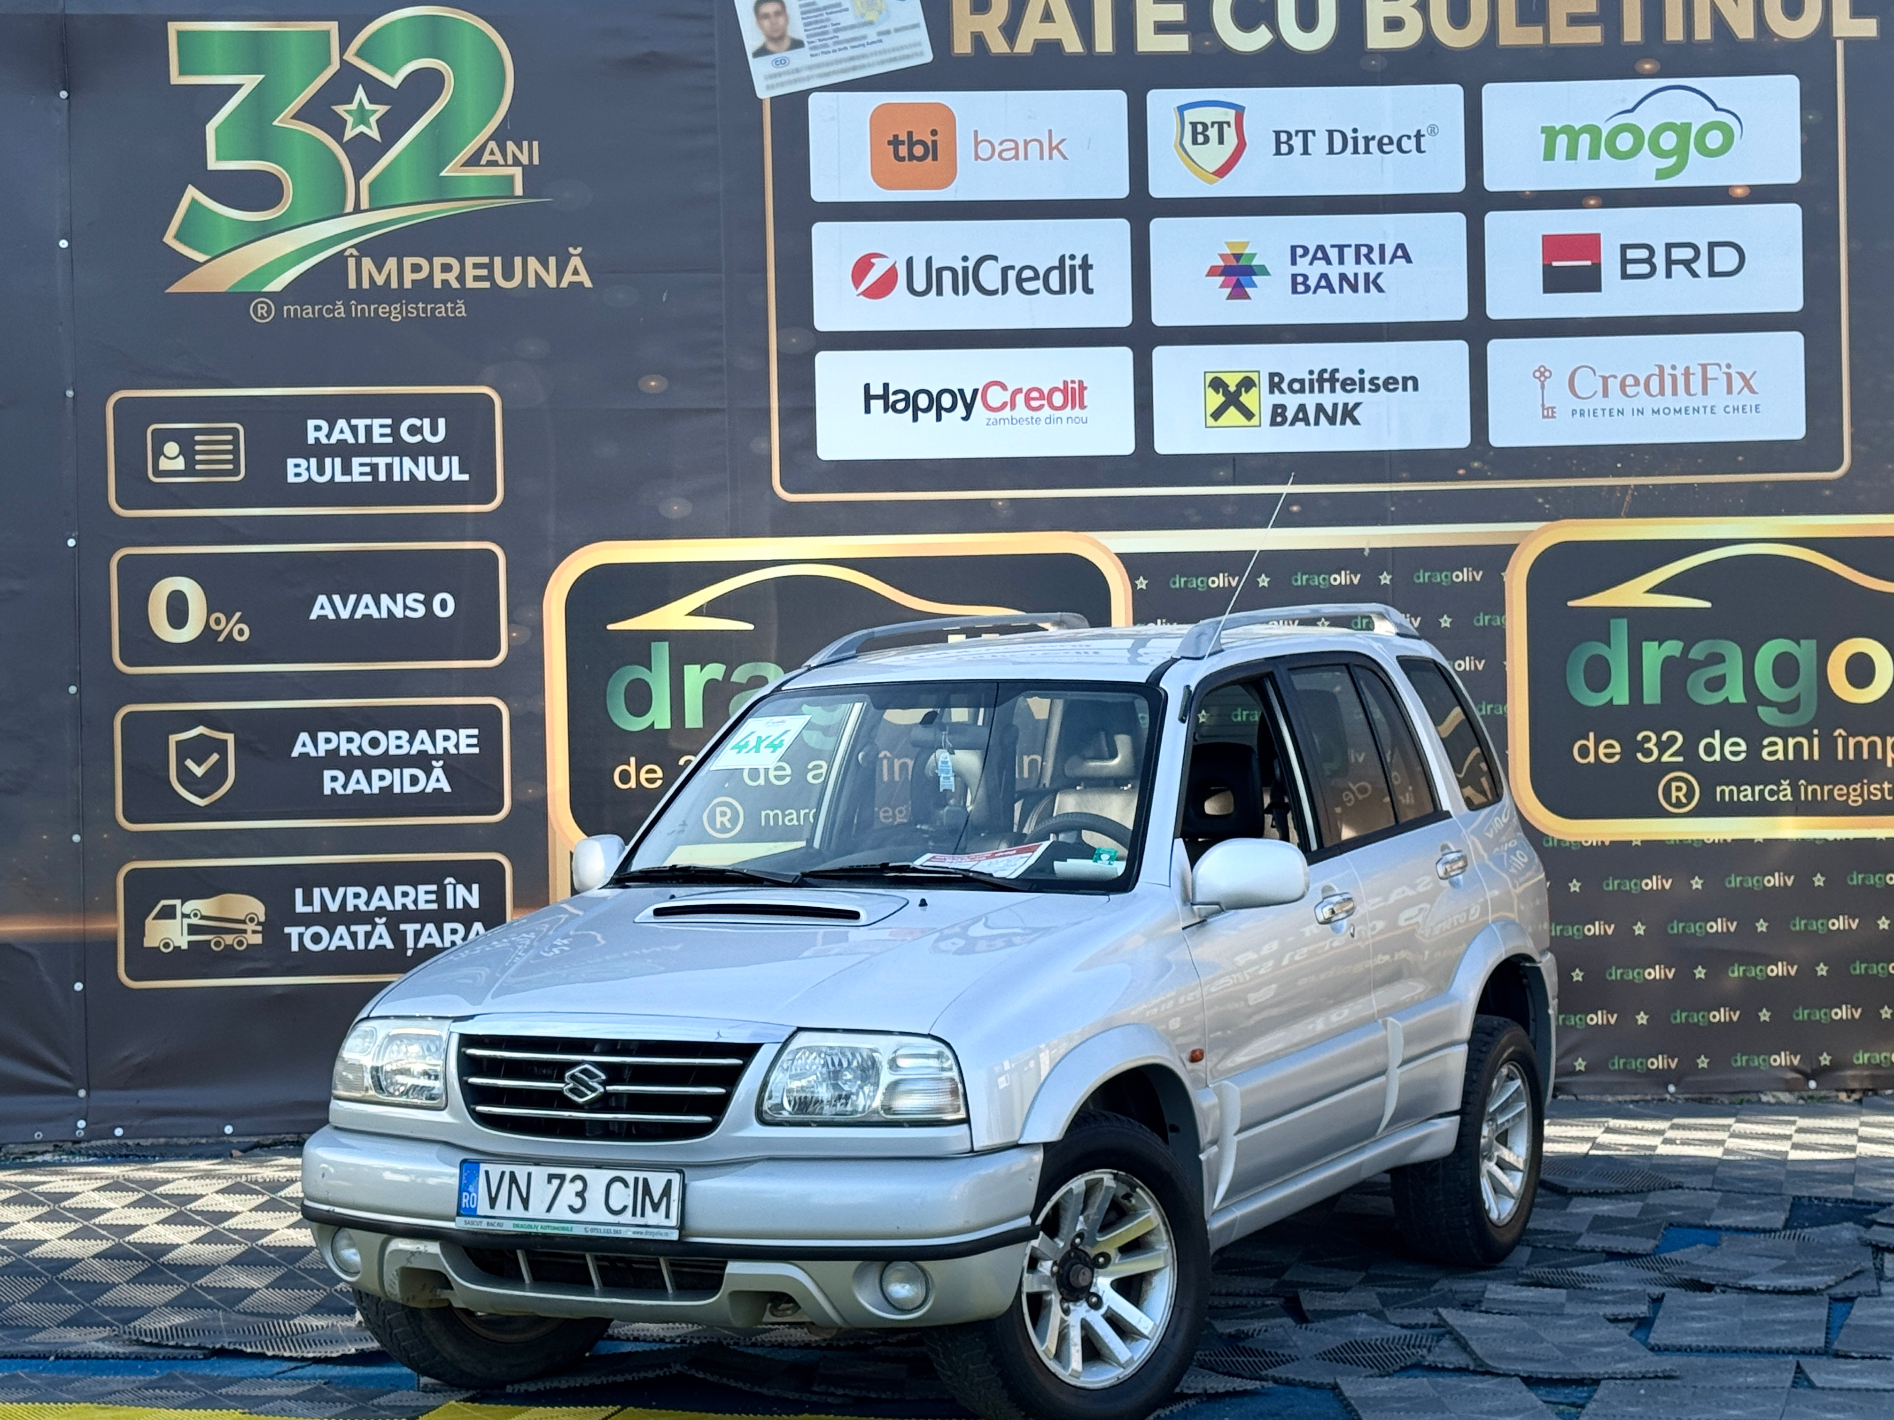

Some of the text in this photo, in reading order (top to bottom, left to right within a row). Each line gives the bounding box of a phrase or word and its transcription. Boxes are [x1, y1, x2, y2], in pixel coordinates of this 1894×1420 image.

[163, 6, 523, 263] 32
[887, 129, 939, 163] tbi
[972, 130, 1069, 162] bank
[1189, 121, 1231, 146] BT
[1272, 129, 1316, 156] BT
[480, 141, 540, 165] ANI
[1541, 120, 1736, 181] mogo
[1290, 243, 1413, 266] PATRIA
[1619, 240, 1746, 280] BRD
[344, 247, 593, 289] ÎMPREUNĂ
[905, 253, 1093, 297] UniCredit
[1291, 272, 1386, 295] BANK
[282, 299, 346, 319] marcă
[349, 299, 467, 323] înregistrată
[1268, 368, 1419, 395] Raiffeisen
[1567, 362, 1759, 400] CreditFix
[863, 380, 1088, 423] HappyCredit
[1571, 404, 1762, 418] PRIETEN IN MOMENTE CHEIE
[985, 414, 1088, 427] zambeste din nou
[1269, 402, 1363, 427] BANK
[306, 417, 447, 444] RATE CU
[286, 457, 470, 483] BULETINUL
[1170, 573, 1239, 591] dragoliv
[1291, 570, 1361, 588] dragoliv
[1413, 567, 1483, 585] dragoliv
[309, 592, 456, 620] AVANS 0
[290, 728, 480, 758] APROBARE
[1572, 732, 1621, 764] de
[1636, 730, 1684, 763] 32
[1698, 730, 1747, 762] de
[1761, 729, 1819, 761] ani
[323, 760, 452, 795] RAPIDĂ
[613, 757, 663, 789] de
[1716, 779, 1793, 801] marcă
[1603, 875, 1673, 894] dragoliv
[1725, 872, 1795, 890] dragoliv
[295, 877, 480, 913] LIVRARE ÎN
[284, 917, 395, 952] TOATĂ
[1667, 918, 1737, 936] dragoliv
[1790, 915, 1860, 934] dragoliv
[1606, 965, 1676, 983] dragoliv
[1728, 961, 1798, 980] dragoliv
[1670, 1007, 1740, 1026] dragoliv
[1793, 1004, 1862, 1023] dragoliv
[1608, 1055, 1678, 1073] dragoliv
[1731, 1051, 1801, 1069] dragoliv
[461, 1191, 477, 1209] RO
[484, 1170, 673, 1219] VN 73 CIM
